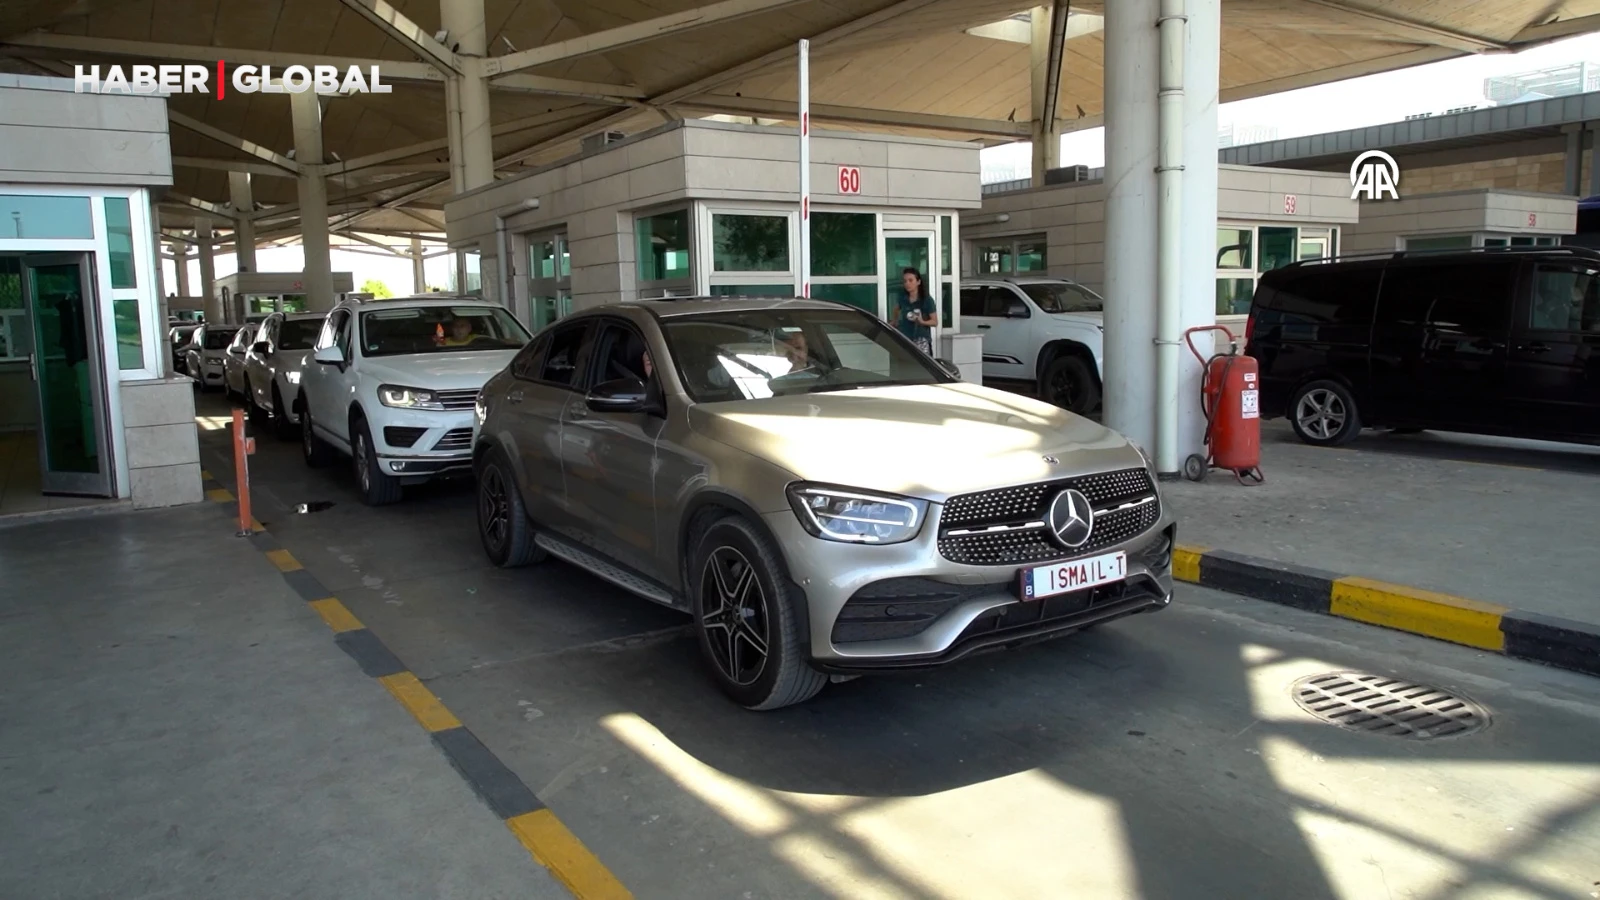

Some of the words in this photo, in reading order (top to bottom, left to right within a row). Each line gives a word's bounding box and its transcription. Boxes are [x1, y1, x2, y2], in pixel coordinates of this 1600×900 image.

[840, 168, 859, 192] 60
[1285, 196, 1295, 213] 59
[1025, 585, 1033, 596] B
